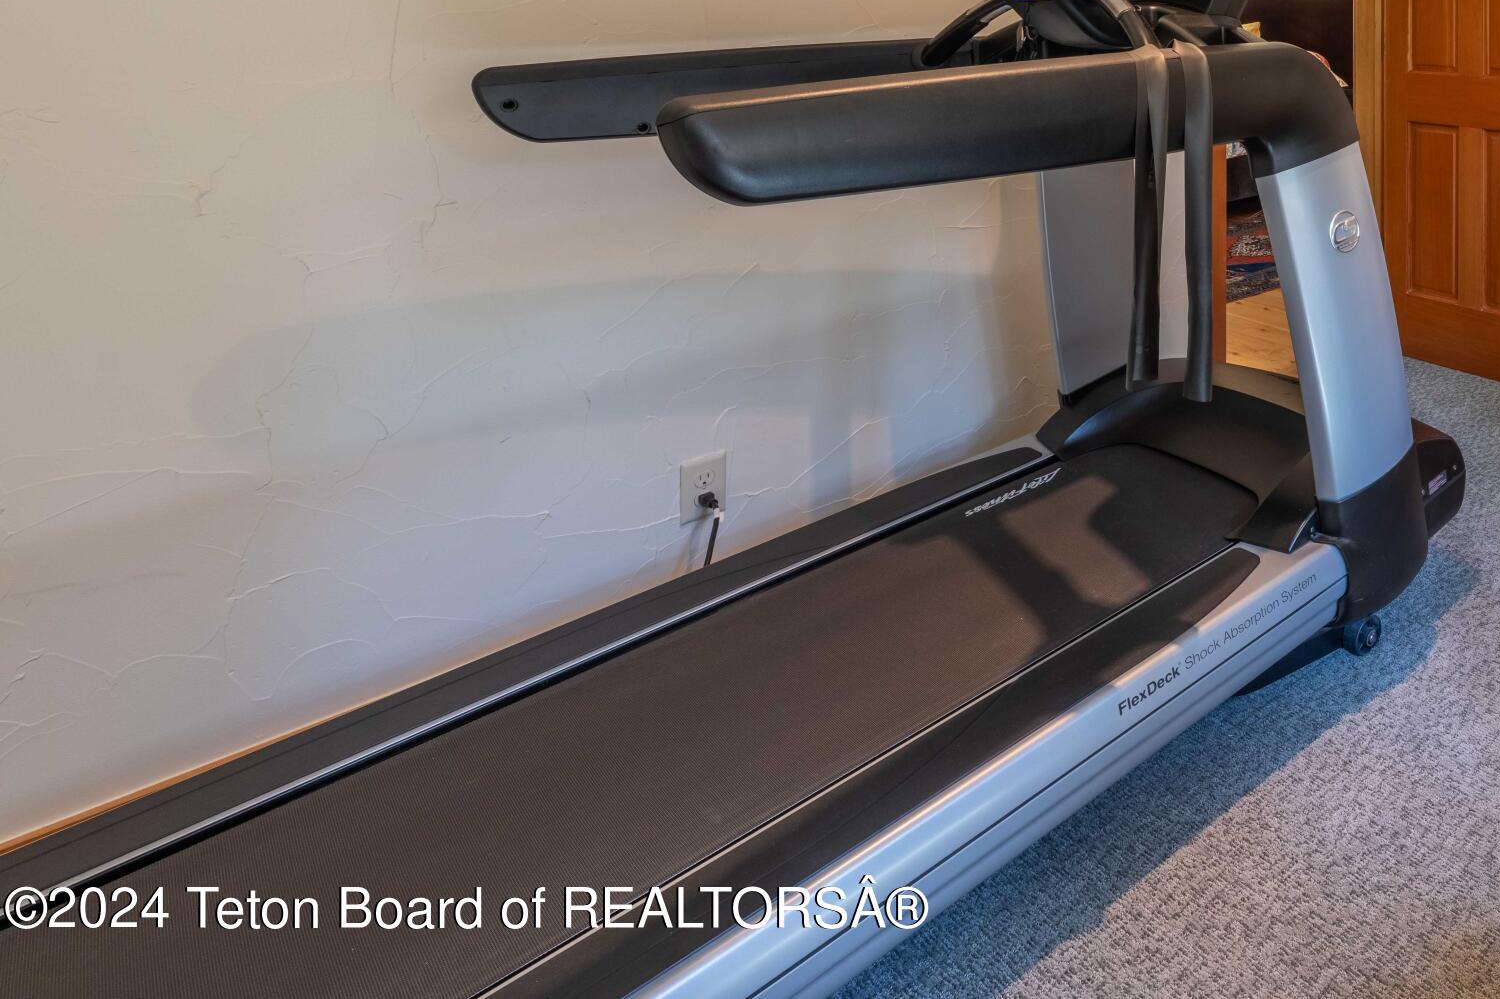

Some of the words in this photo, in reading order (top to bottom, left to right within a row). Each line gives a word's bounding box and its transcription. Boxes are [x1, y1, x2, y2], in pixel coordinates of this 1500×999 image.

[1118, 666, 1180, 716] FlexDeck
[1184, 639, 1221, 671] Shock
[1223, 597, 1280, 645] Absorption
[1281, 573, 1318, 604] System
